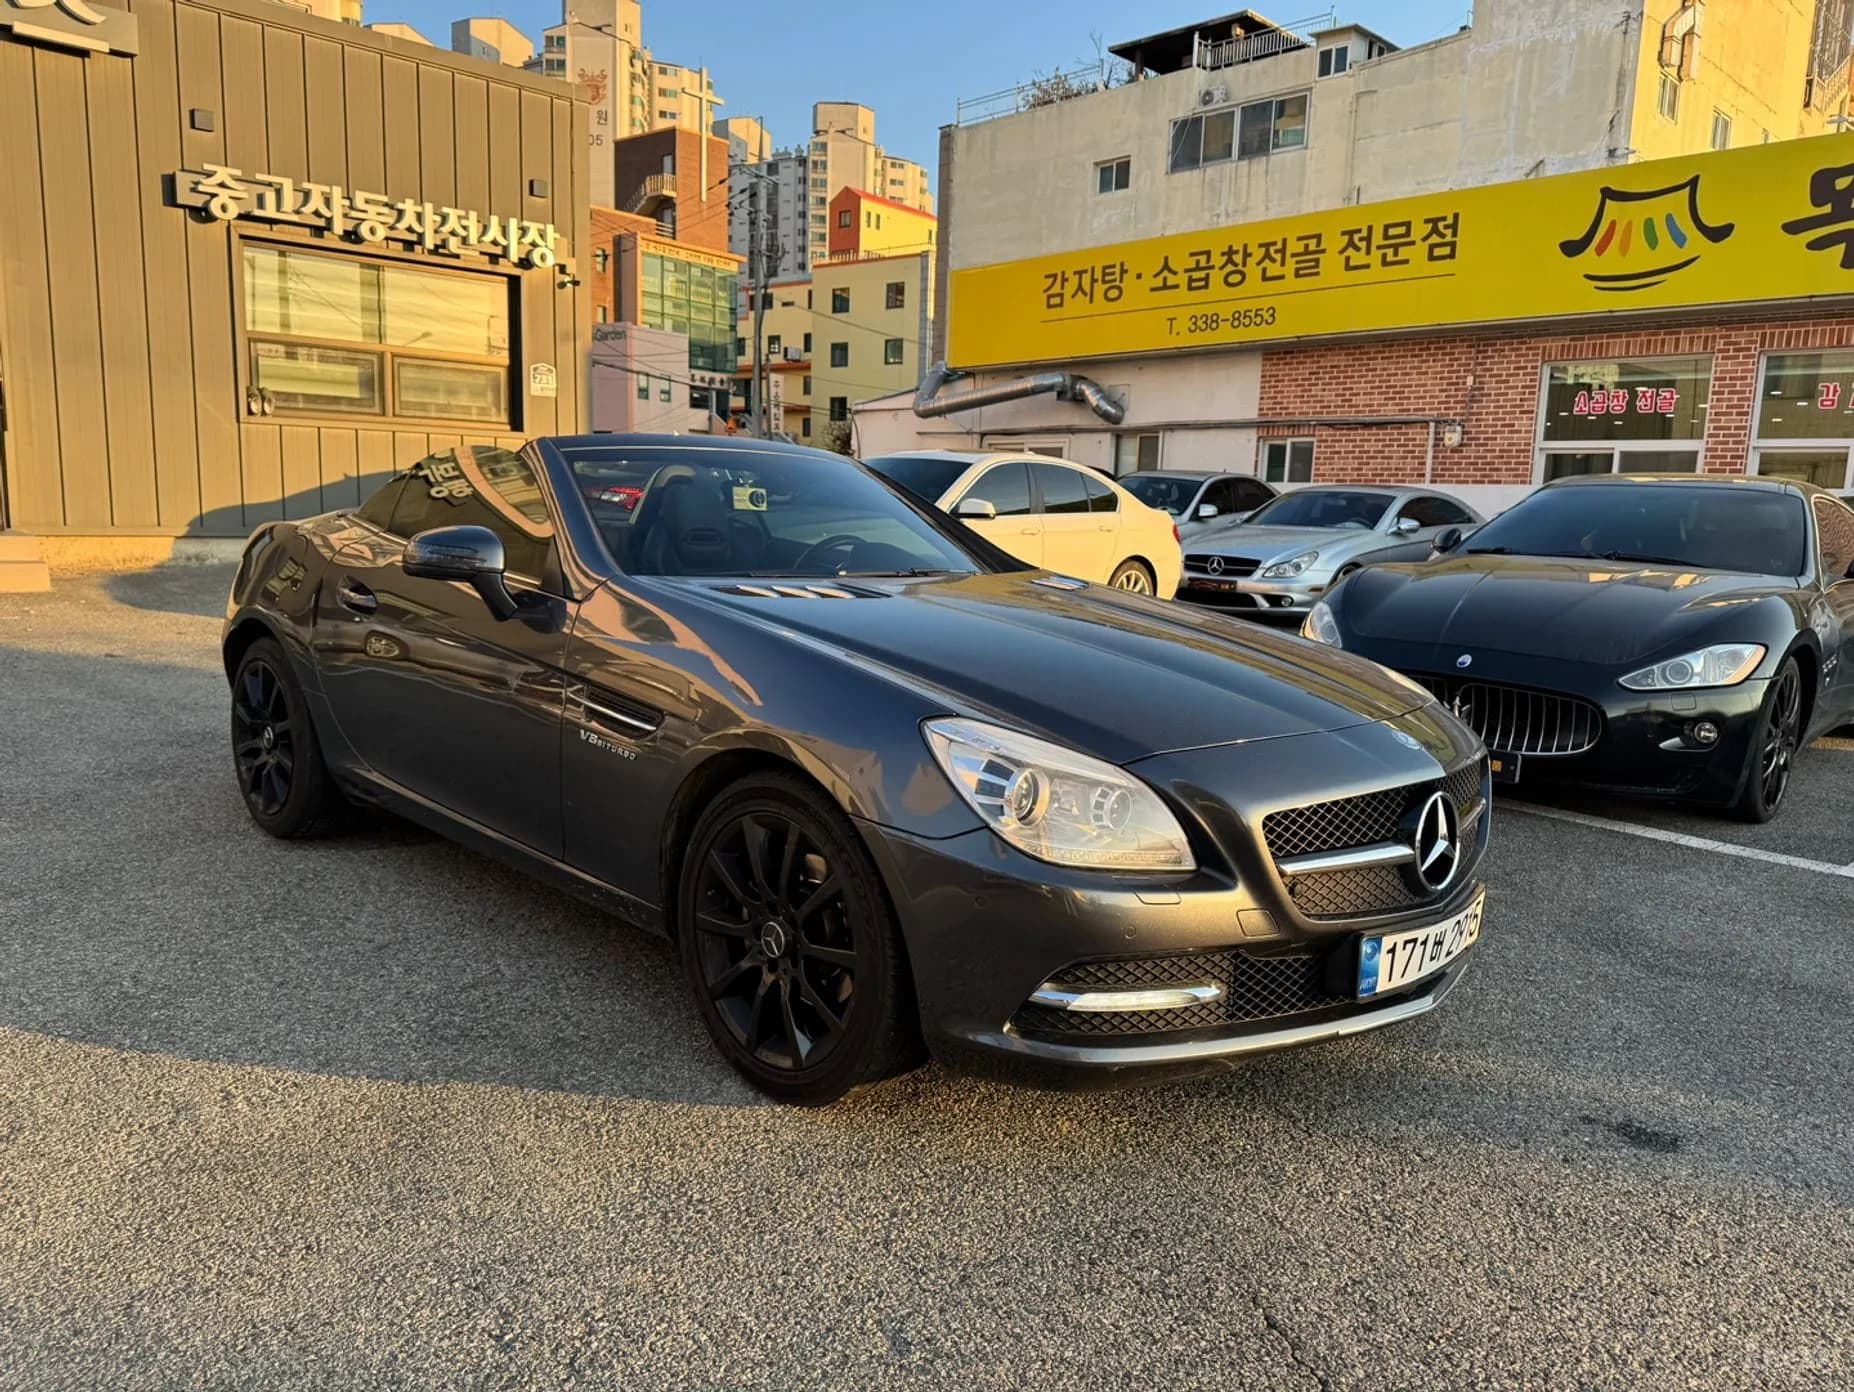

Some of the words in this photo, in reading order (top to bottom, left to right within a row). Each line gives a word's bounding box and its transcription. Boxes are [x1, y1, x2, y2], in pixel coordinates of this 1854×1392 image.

[197, 163, 560, 268] 중고자동차전시장
[1338, 212, 1461, 273] 전문점
[1166, 317, 1181, 336] T.
[1187, 306, 1277, 334] 338-8553
[1636, 388, 1676, 413] 전골
